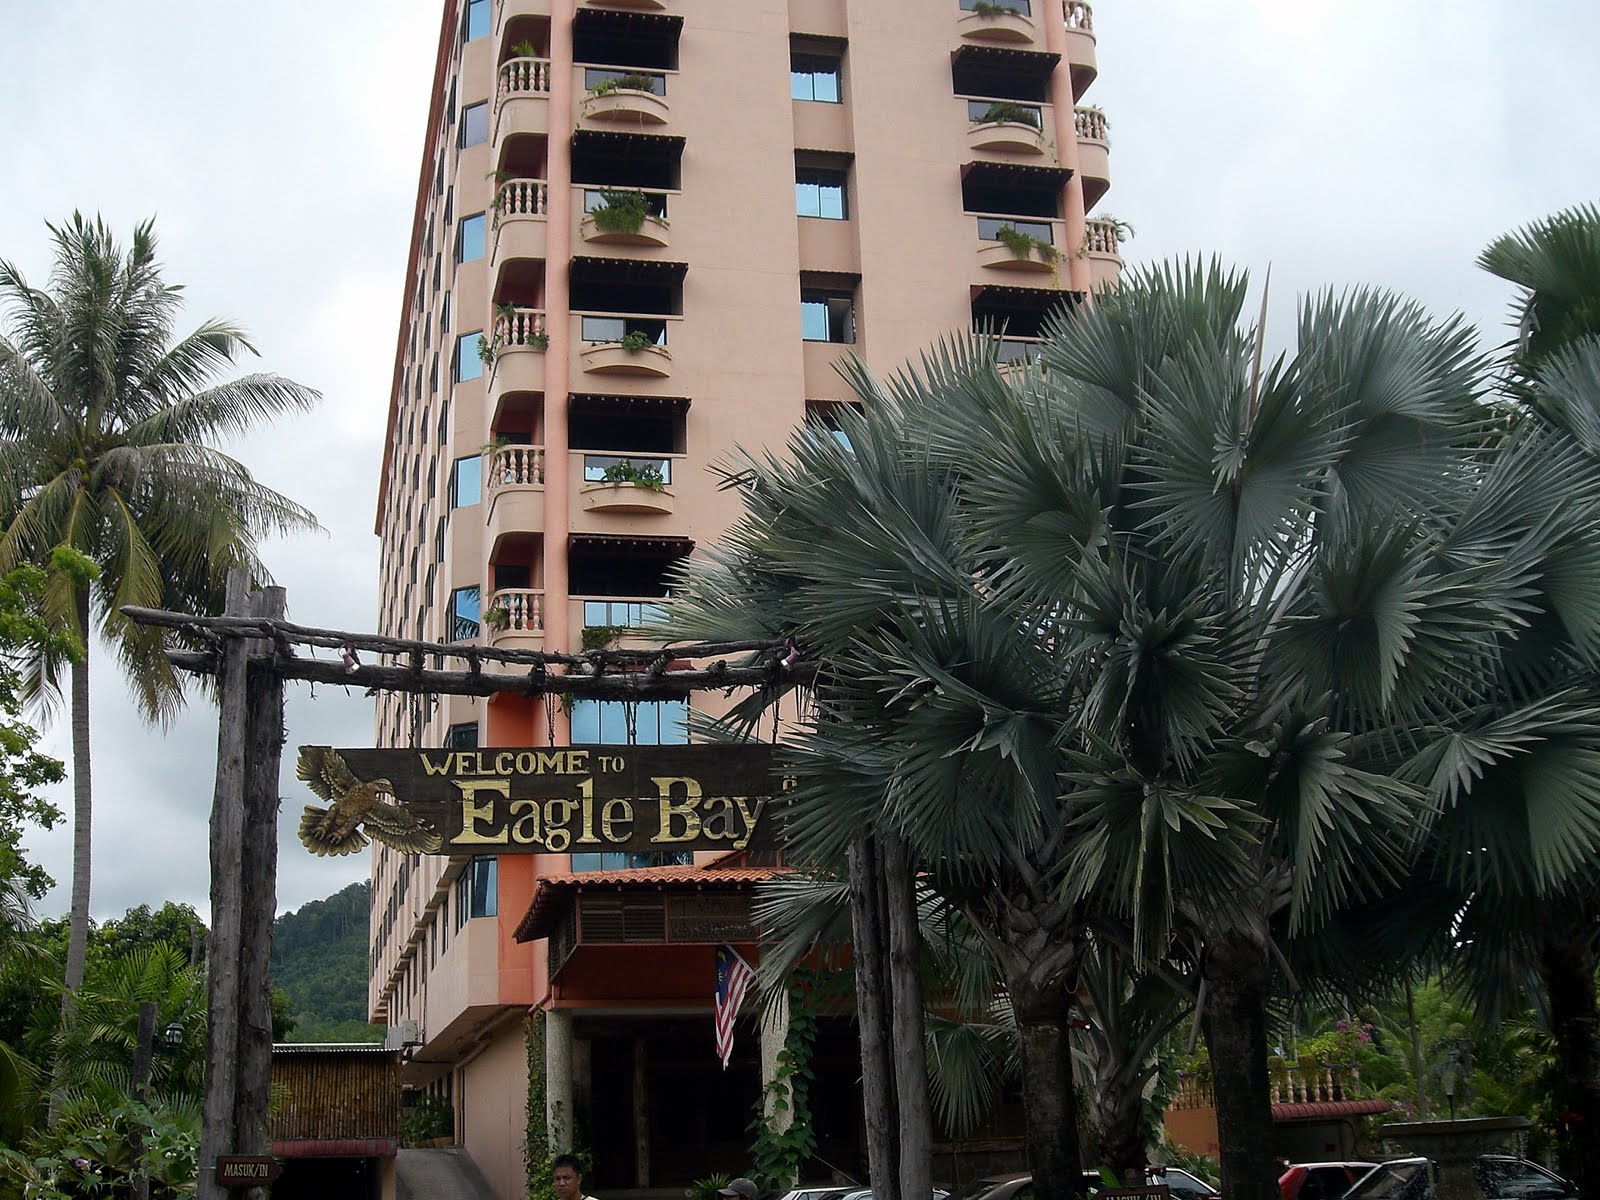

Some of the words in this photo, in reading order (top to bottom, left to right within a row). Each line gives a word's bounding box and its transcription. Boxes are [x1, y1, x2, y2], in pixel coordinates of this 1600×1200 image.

[419, 750, 590, 776] WELCOME
[599, 756, 626, 774] TO
[450, 777, 634, 852] Eagle
[649, 776, 769, 851] Bay
[224, 1163, 269, 1177] MASUK/IN
